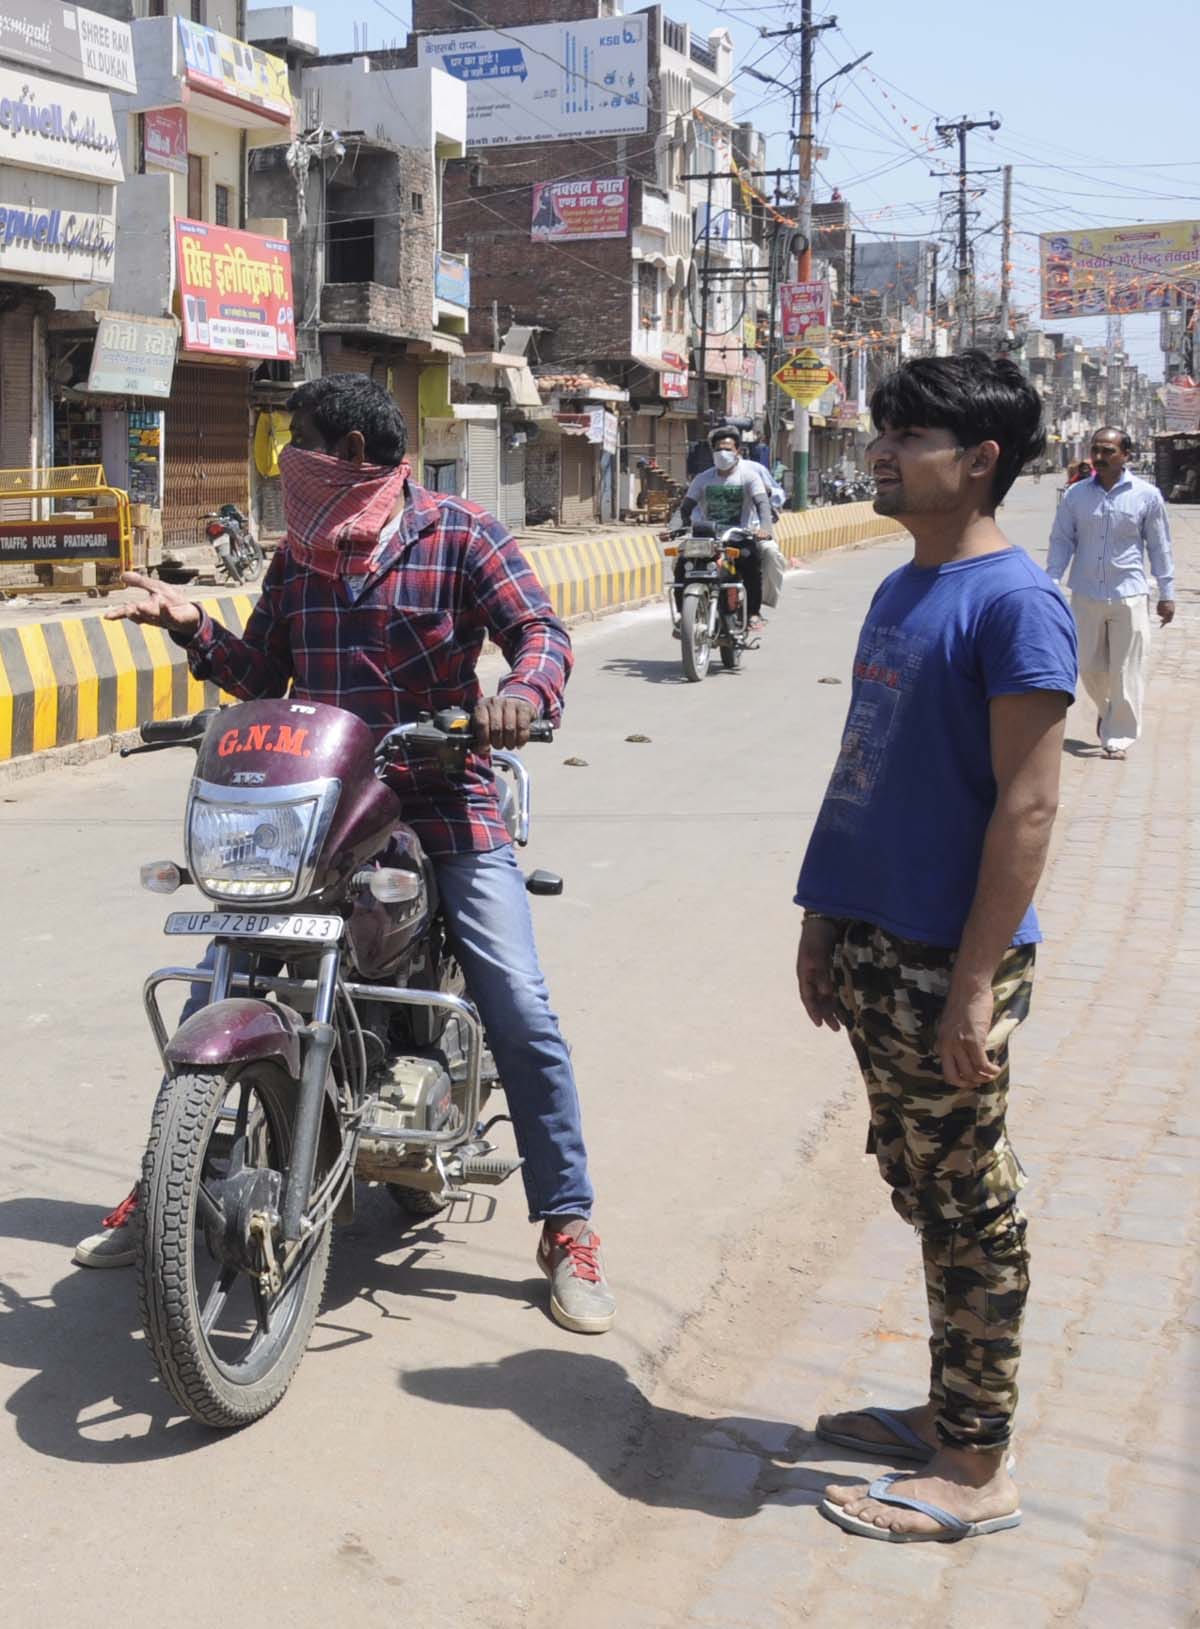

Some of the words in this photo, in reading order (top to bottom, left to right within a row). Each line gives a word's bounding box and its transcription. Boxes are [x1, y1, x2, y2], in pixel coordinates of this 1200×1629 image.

[81, 20, 110, 48] SHREE
[112, 29, 130, 55] RAM
[86, 48, 97, 69] KI
[99, 52, 128, 80] DUKAN
[68, 111, 119, 167] Gallery
[595, 179, 624, 193] लाल
[182, 236, 212, 289] सिंह
[0, 536, 27, 550] TRAFFIC
[32, 535, 57, 549] POLICE
[63, 533, 107, 548] PRATAPGARH
[218, 723, 312, 758] G.N.M.
[232, 771, 267, 785] TVS
